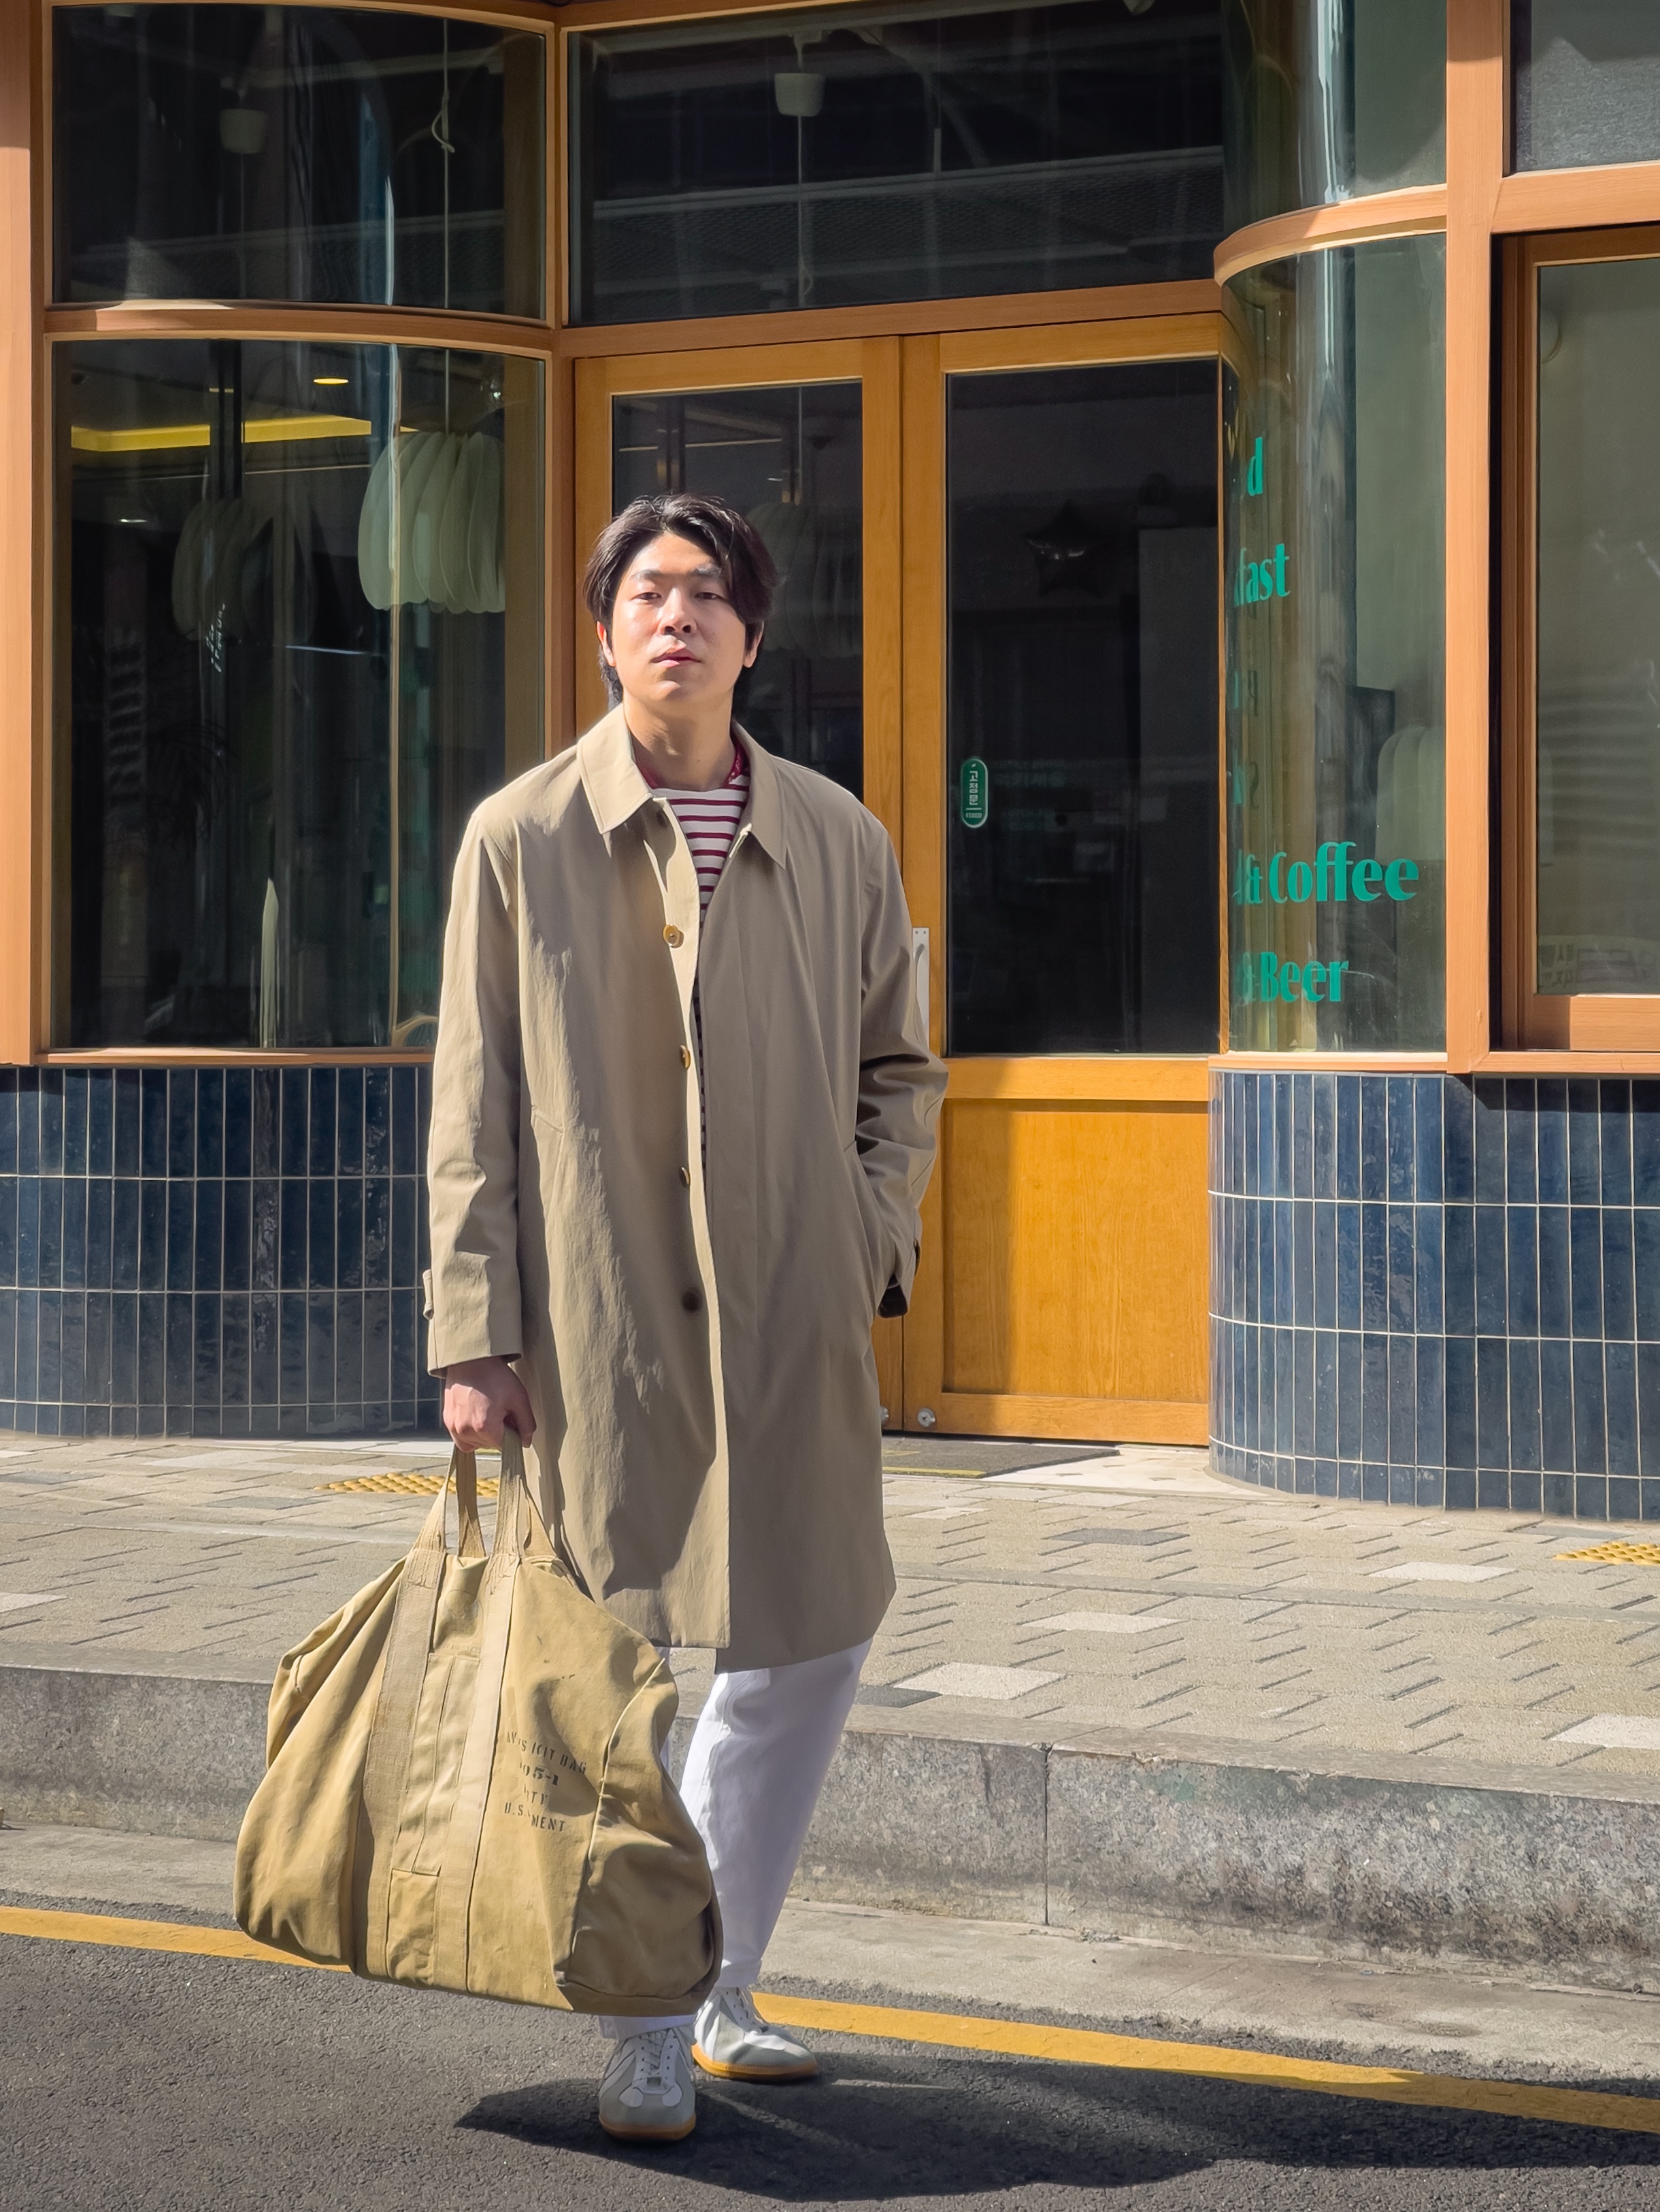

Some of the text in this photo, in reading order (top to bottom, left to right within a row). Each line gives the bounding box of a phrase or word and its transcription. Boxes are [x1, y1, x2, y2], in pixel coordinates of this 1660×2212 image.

[969, 771, 978, 805] 고정문
[1269, 841, 1419, 904] Coffee
[1261, 951, 1349, 1003] Beer
[559, 1754, 586, 1775] BAG
